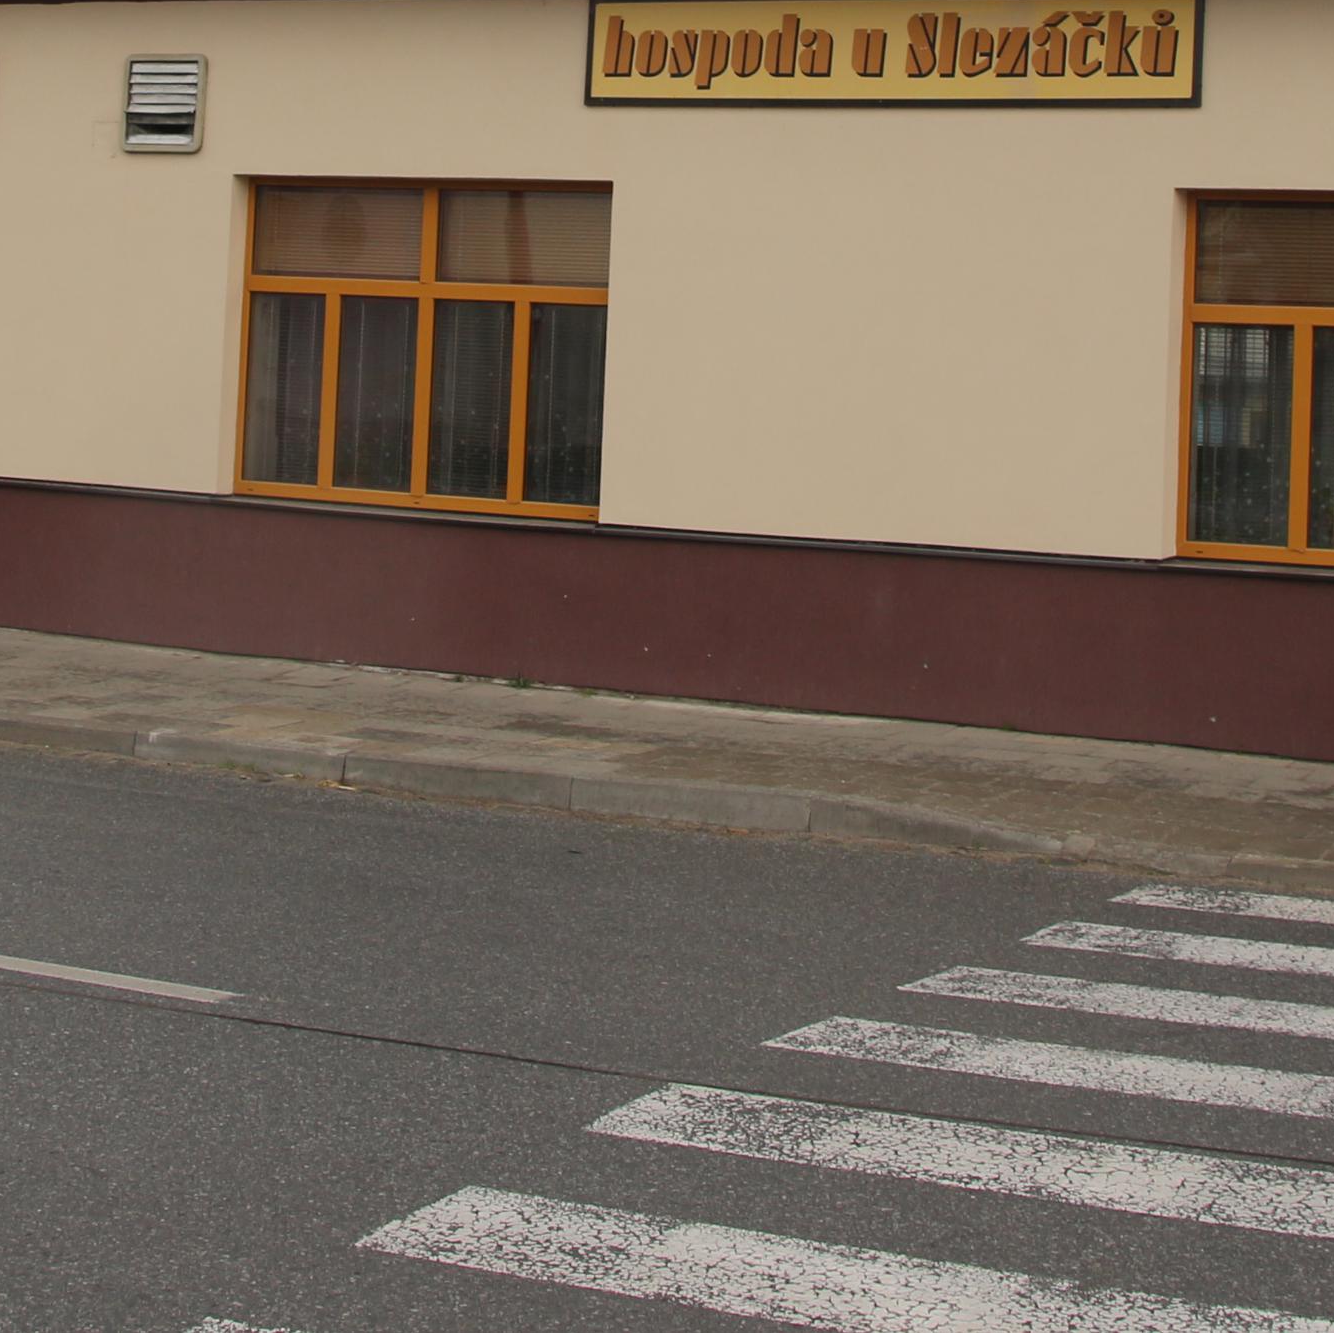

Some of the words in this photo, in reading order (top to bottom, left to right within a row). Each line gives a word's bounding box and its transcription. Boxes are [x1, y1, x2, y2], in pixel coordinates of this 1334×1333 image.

[603, 13, 834, 90] hospoda
[851, 28, 888, 78] u
[905, 9, 1179, 78] Slezáčků
